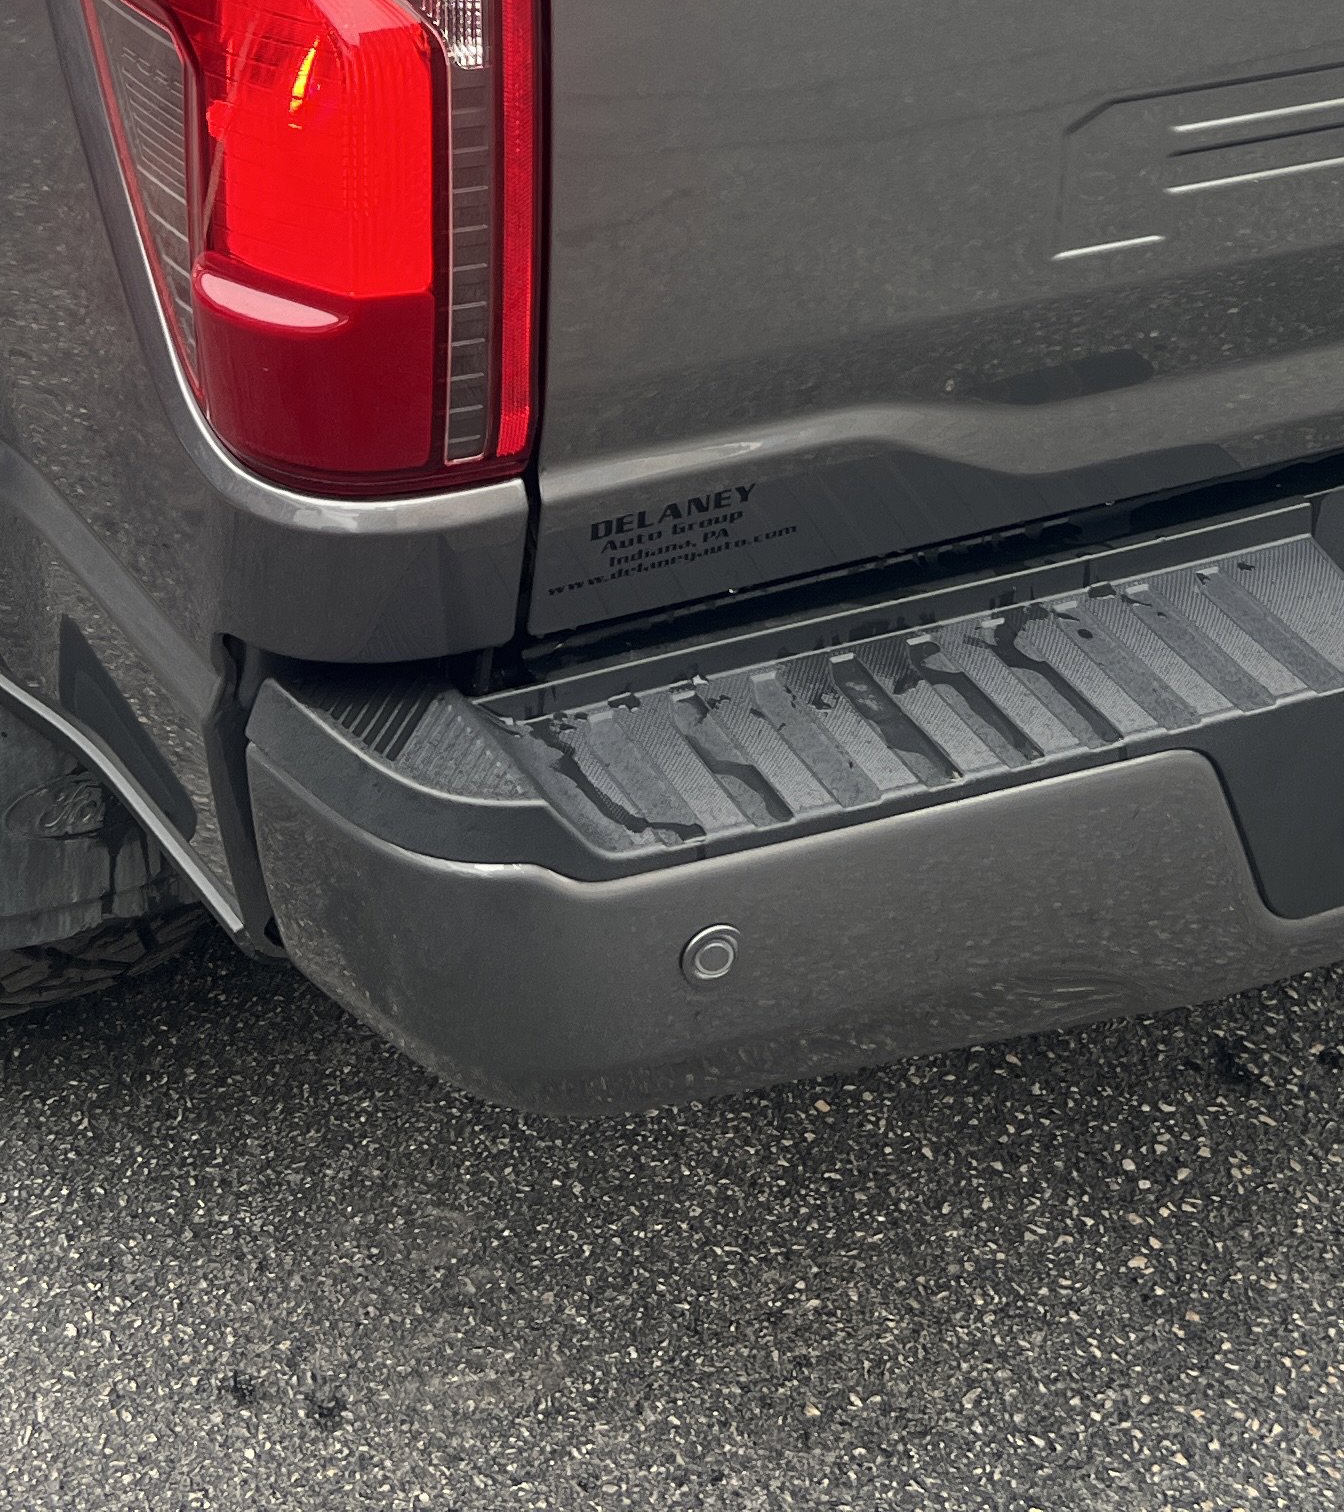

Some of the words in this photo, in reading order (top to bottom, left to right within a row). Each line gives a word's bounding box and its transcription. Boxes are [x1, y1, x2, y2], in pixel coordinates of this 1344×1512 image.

[590, 483, 756, 542] DELANEY
[601, 530, 663, 555] Auto
[672, 510, 744, 535] Group
[703, 527, 729, 543] PA
